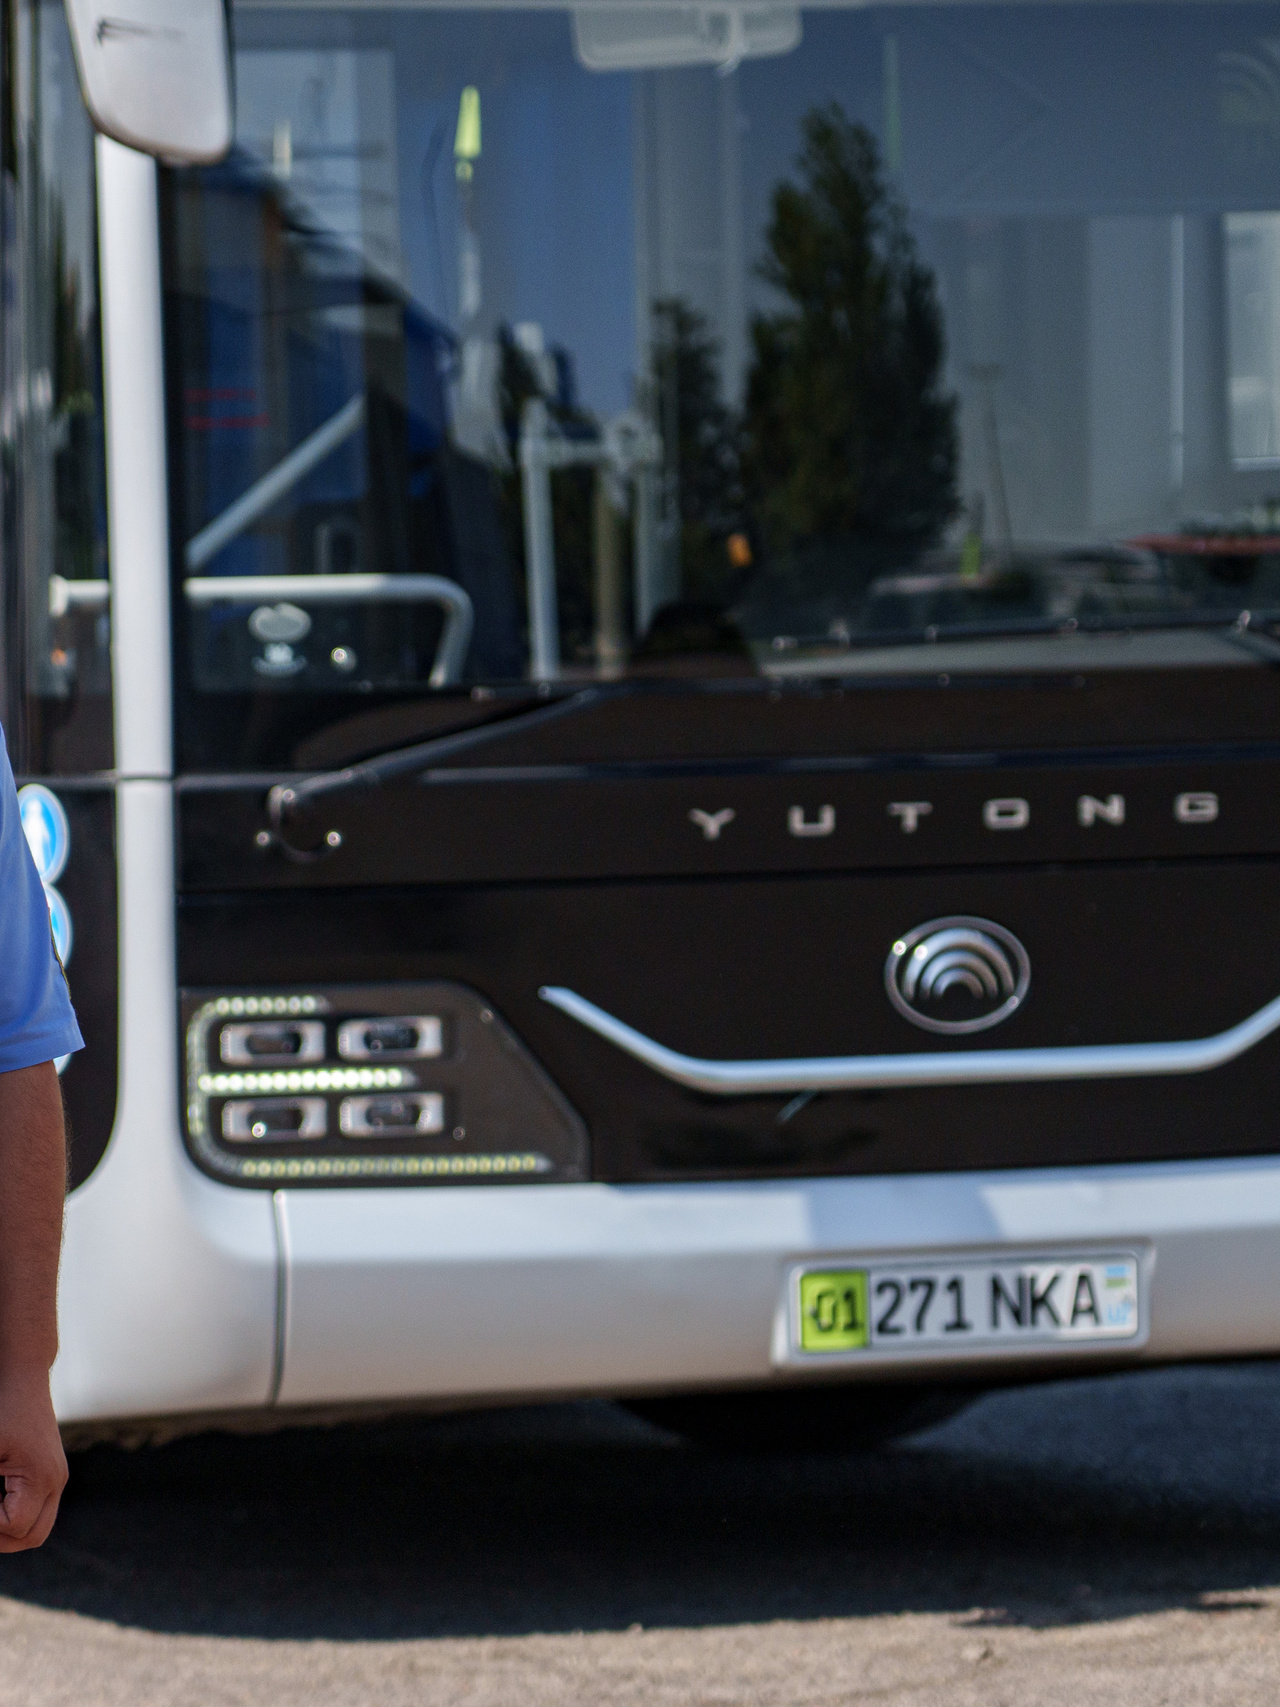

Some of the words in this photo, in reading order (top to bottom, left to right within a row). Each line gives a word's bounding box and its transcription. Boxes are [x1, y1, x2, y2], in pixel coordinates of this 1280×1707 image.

[688, 792, 1220, 841] YUTONG
[811, 1288, 864, 1333] 01
[874, 1276, 972, 1335] 271
[990, 1270, 1101, 1330] NKA
